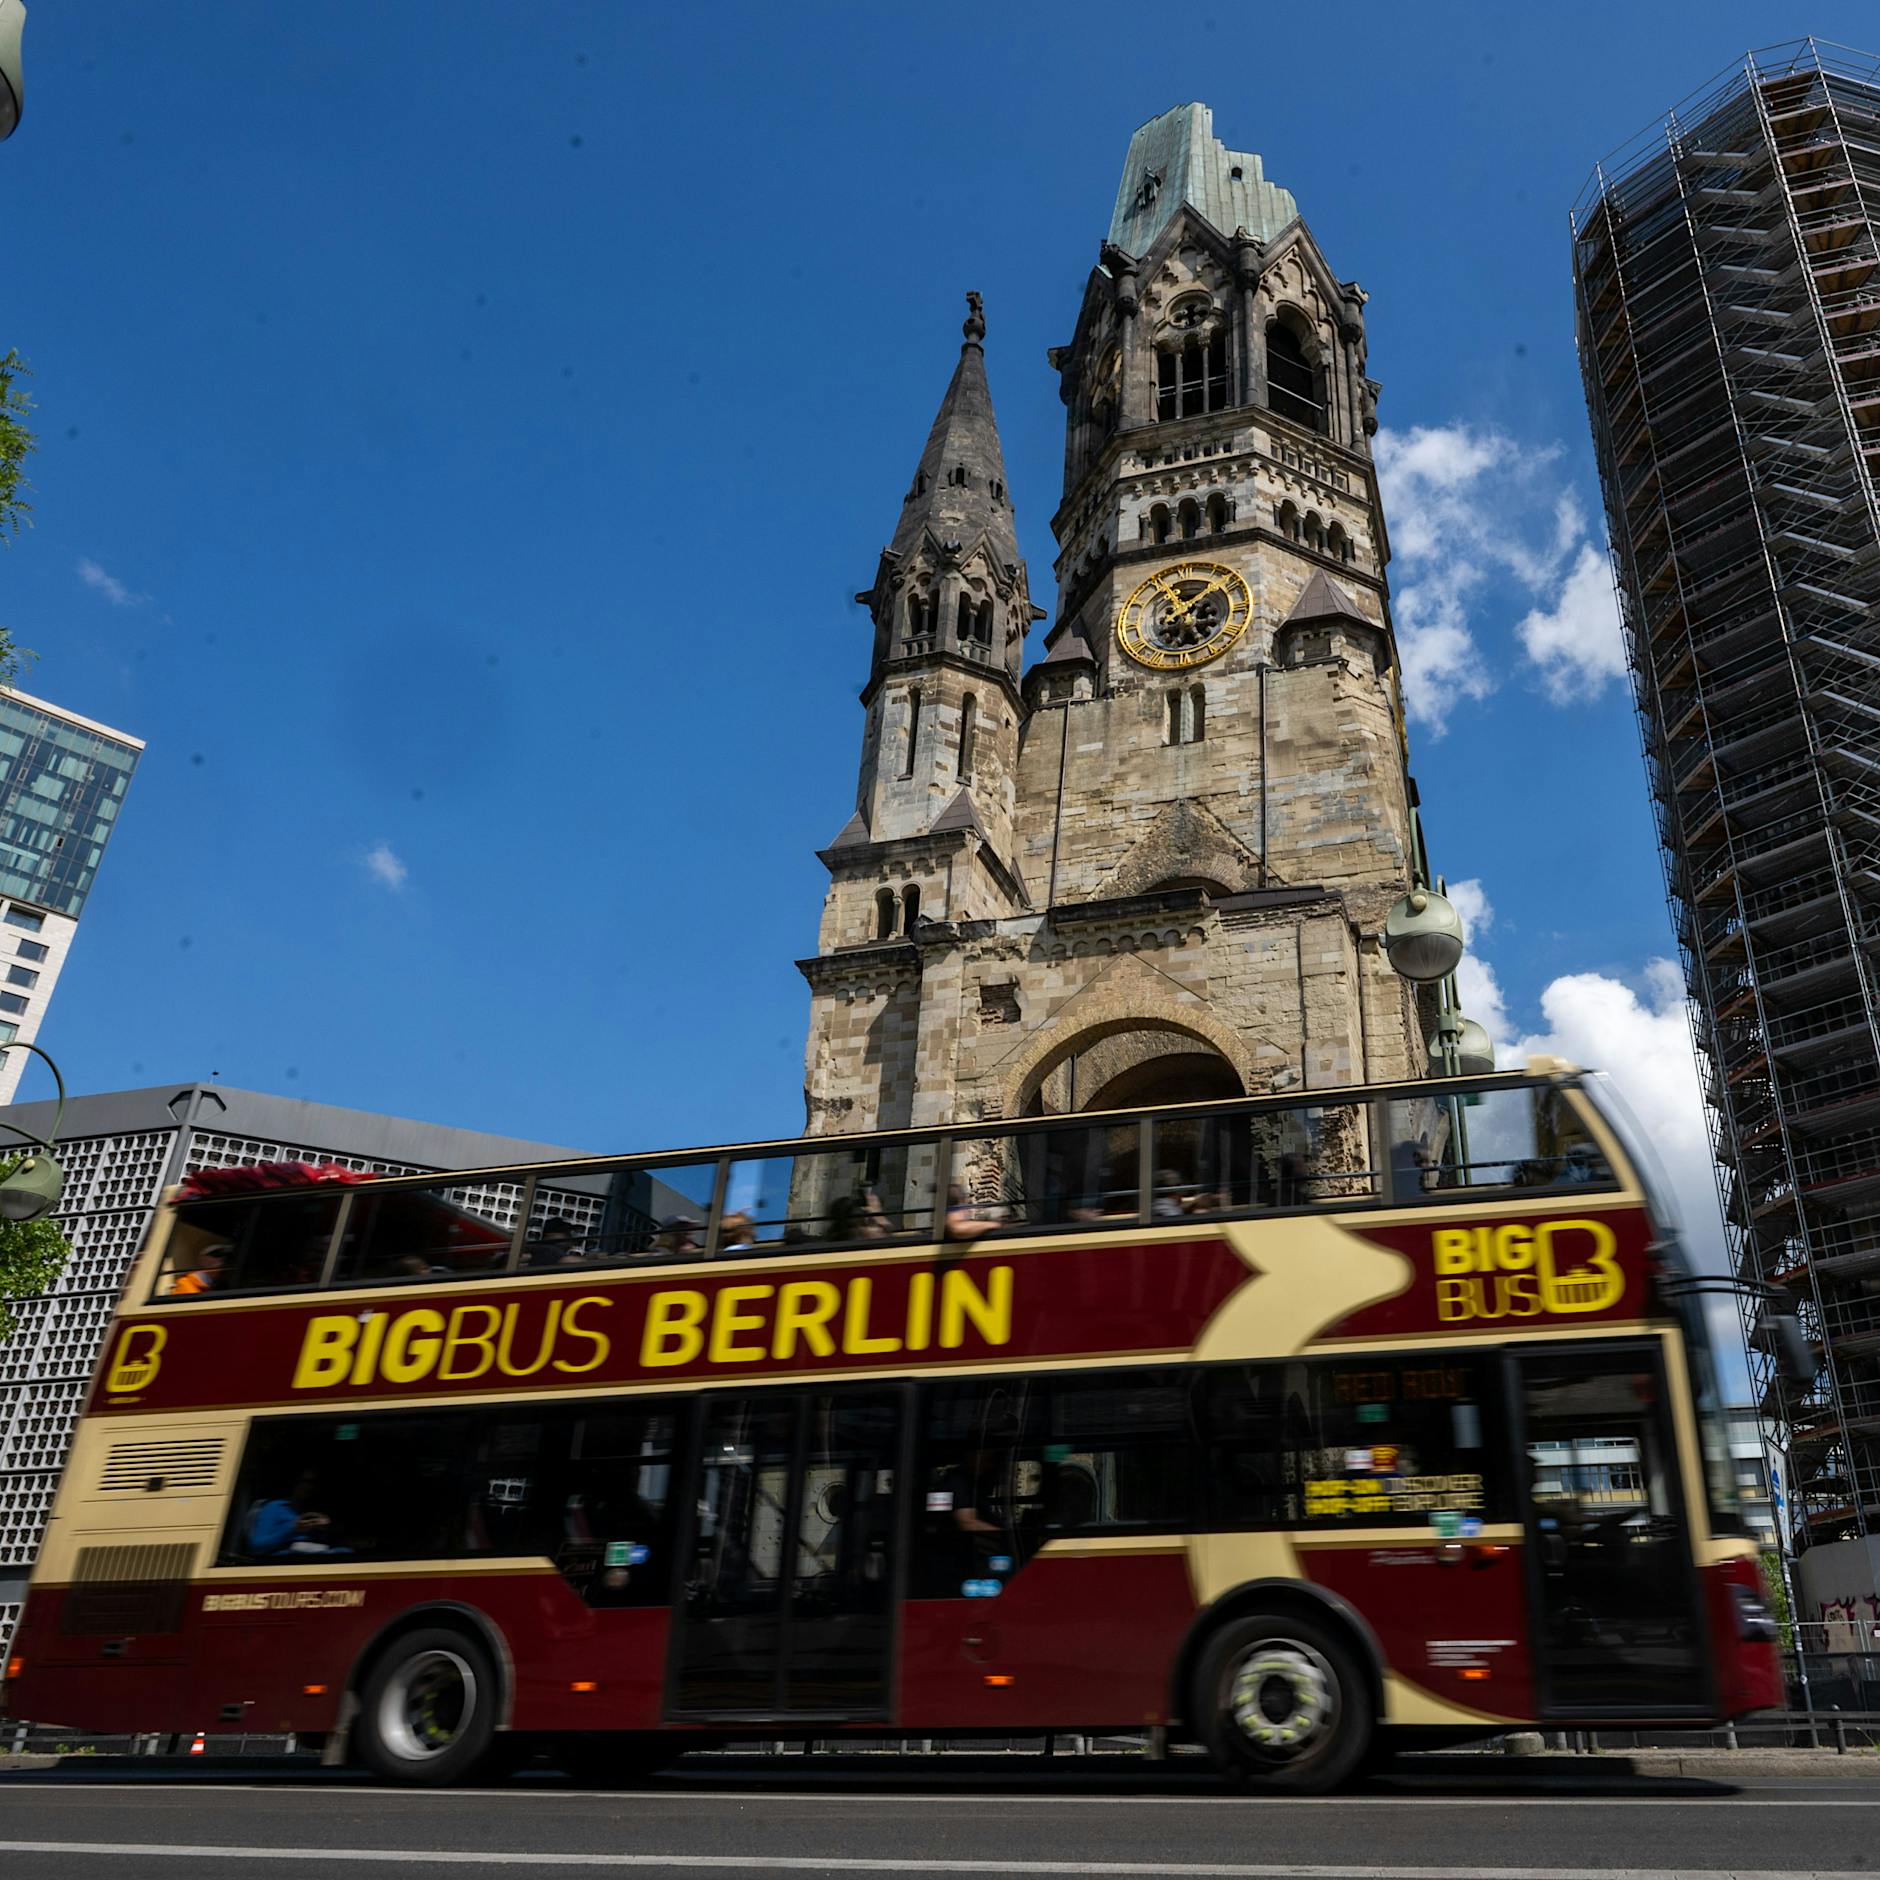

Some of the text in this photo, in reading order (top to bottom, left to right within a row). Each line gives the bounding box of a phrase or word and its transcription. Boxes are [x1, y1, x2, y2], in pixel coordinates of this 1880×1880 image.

[1432, 1224, 1536, 1275] BIG
[639, 1265, 1014, 1367] BERLIN
[1436, 1274, 1544, 1321] BUS
